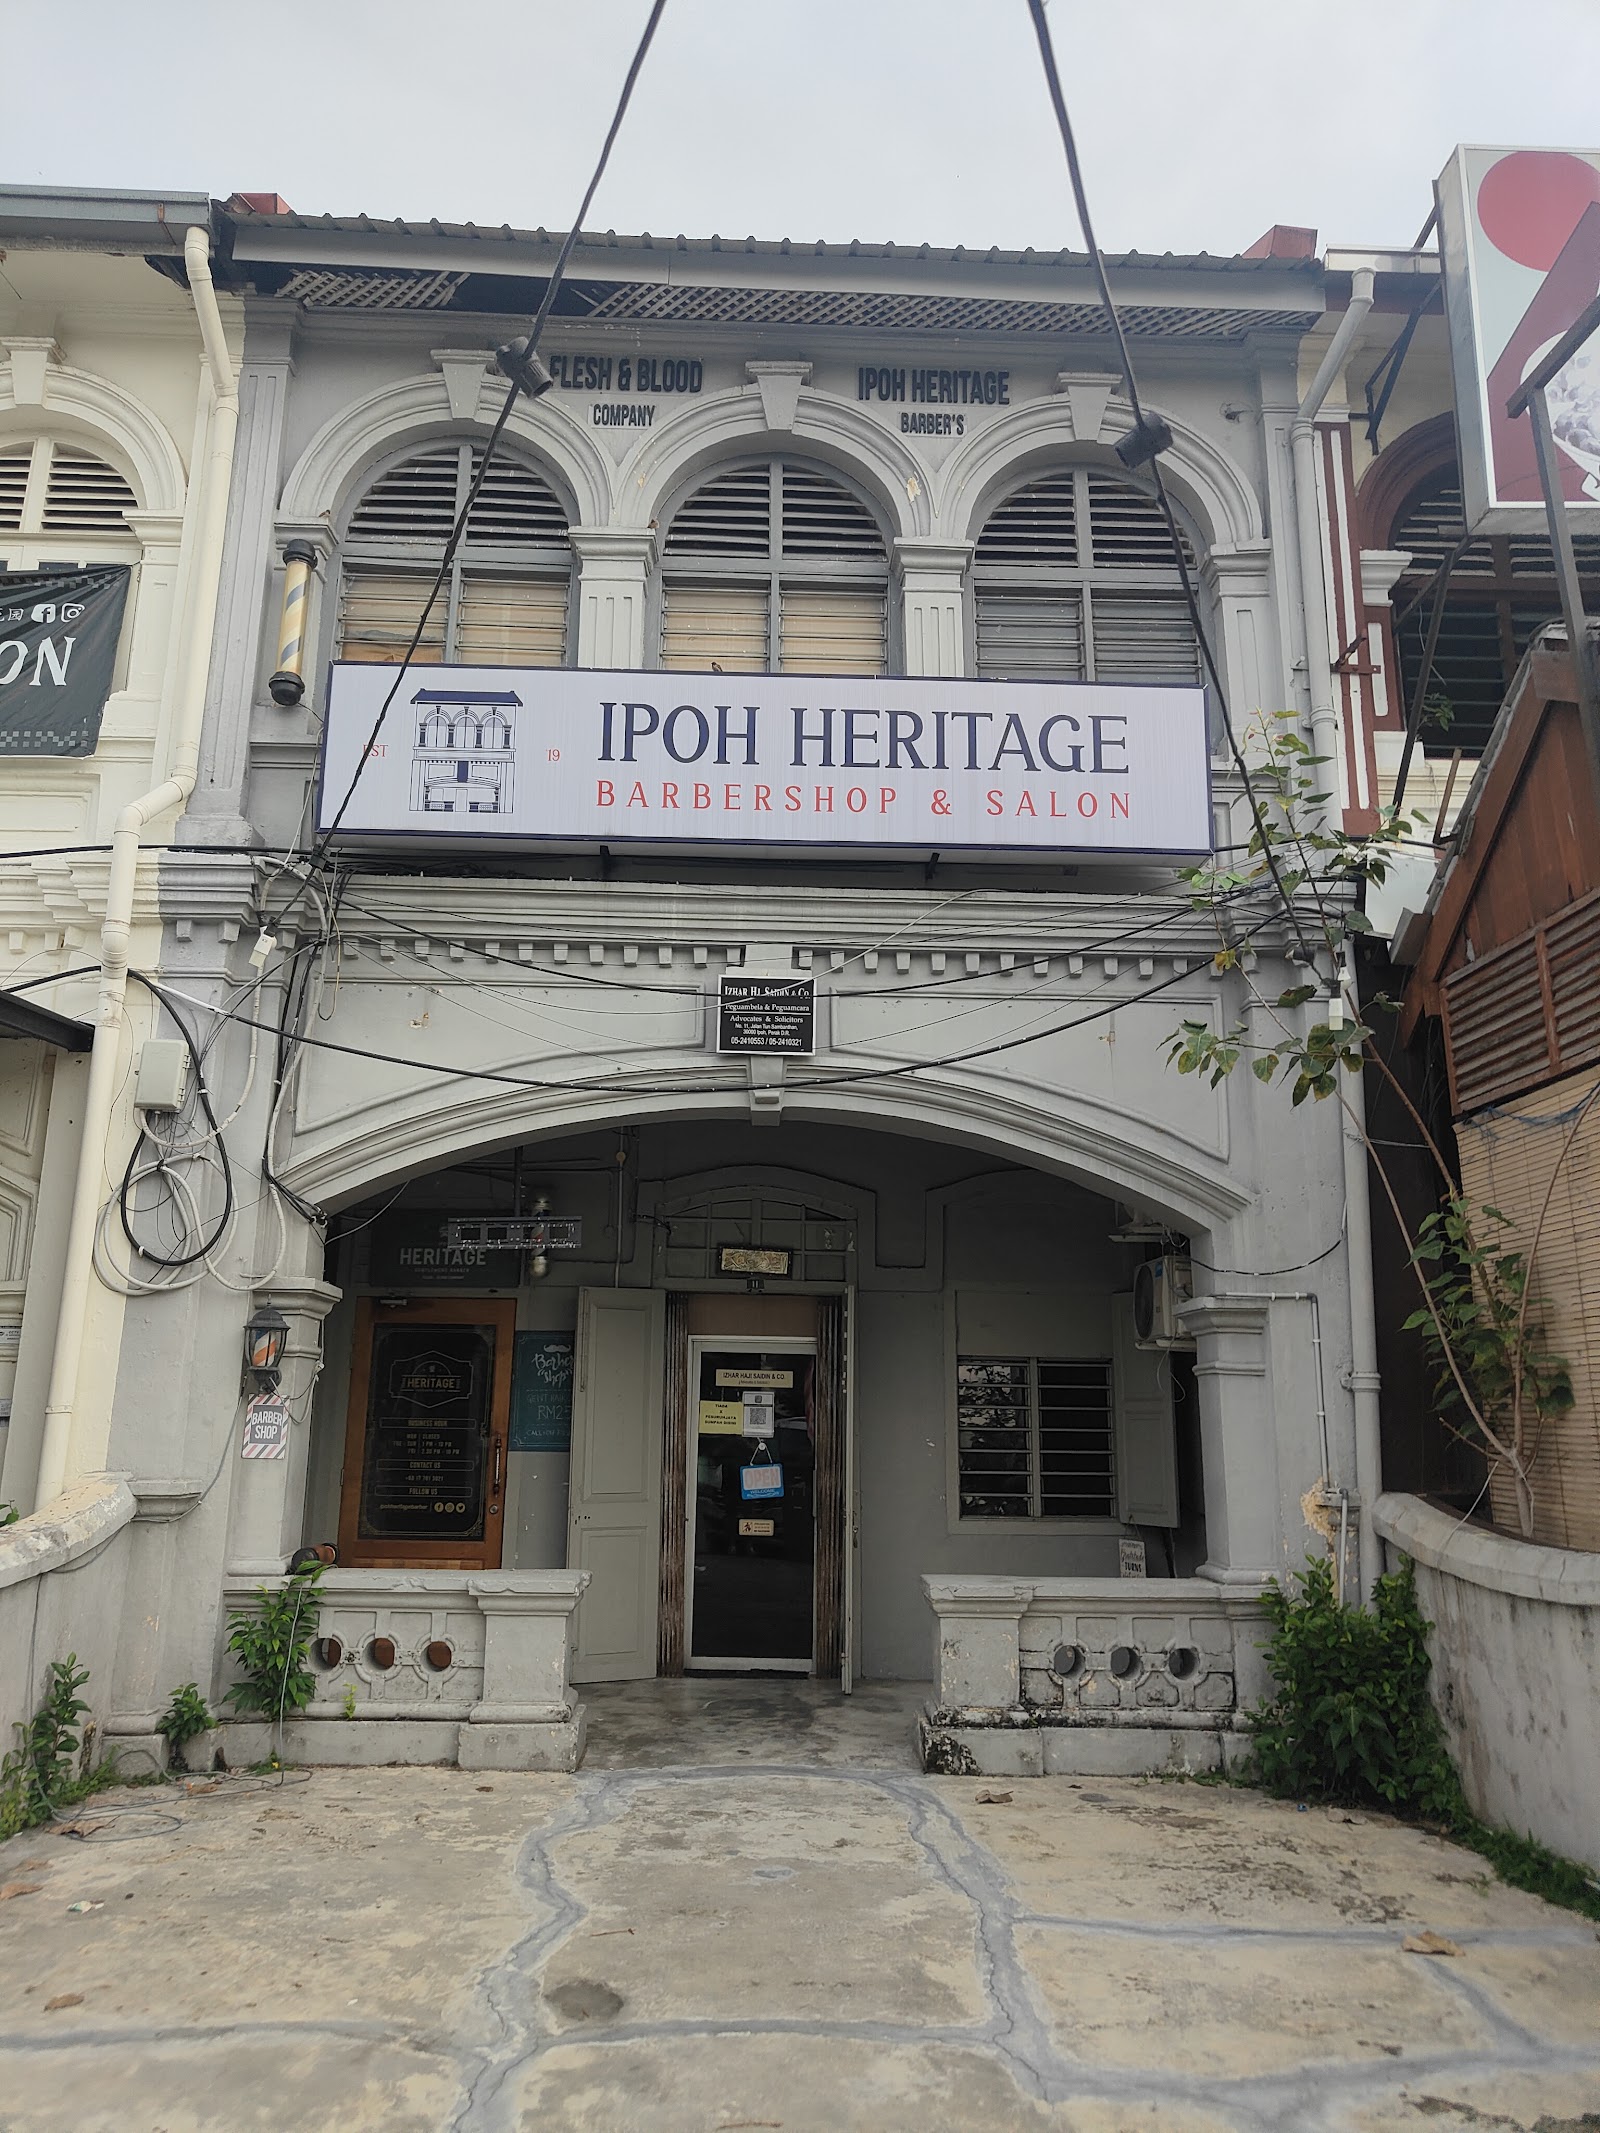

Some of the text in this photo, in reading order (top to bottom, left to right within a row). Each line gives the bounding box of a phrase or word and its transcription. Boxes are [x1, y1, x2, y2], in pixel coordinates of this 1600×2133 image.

[550, 355, 702, 392] FLESH & BLOOD
[858, 367, 1009, 404] IPOH HERITAGE
[593, 404, 655, 426] COMPANY
[901, 412, 964, 434] BARBER'S
[598, 703, 1129, 773] IPOH HERITAGE
[596, 780, 1130, 818] BARBERSHOP & SALON
[772, 1004, 809, 1013] Peguamcara
[400, 1248, 486, 1265] HERITAGE
[407, 1378, 455, 1388] HERITAGE
[252, 1411, 282, 1426] BARBER
[254, 1425, 278, 1439] SHOP
[745, 1468, 779, 1488] OPEN
